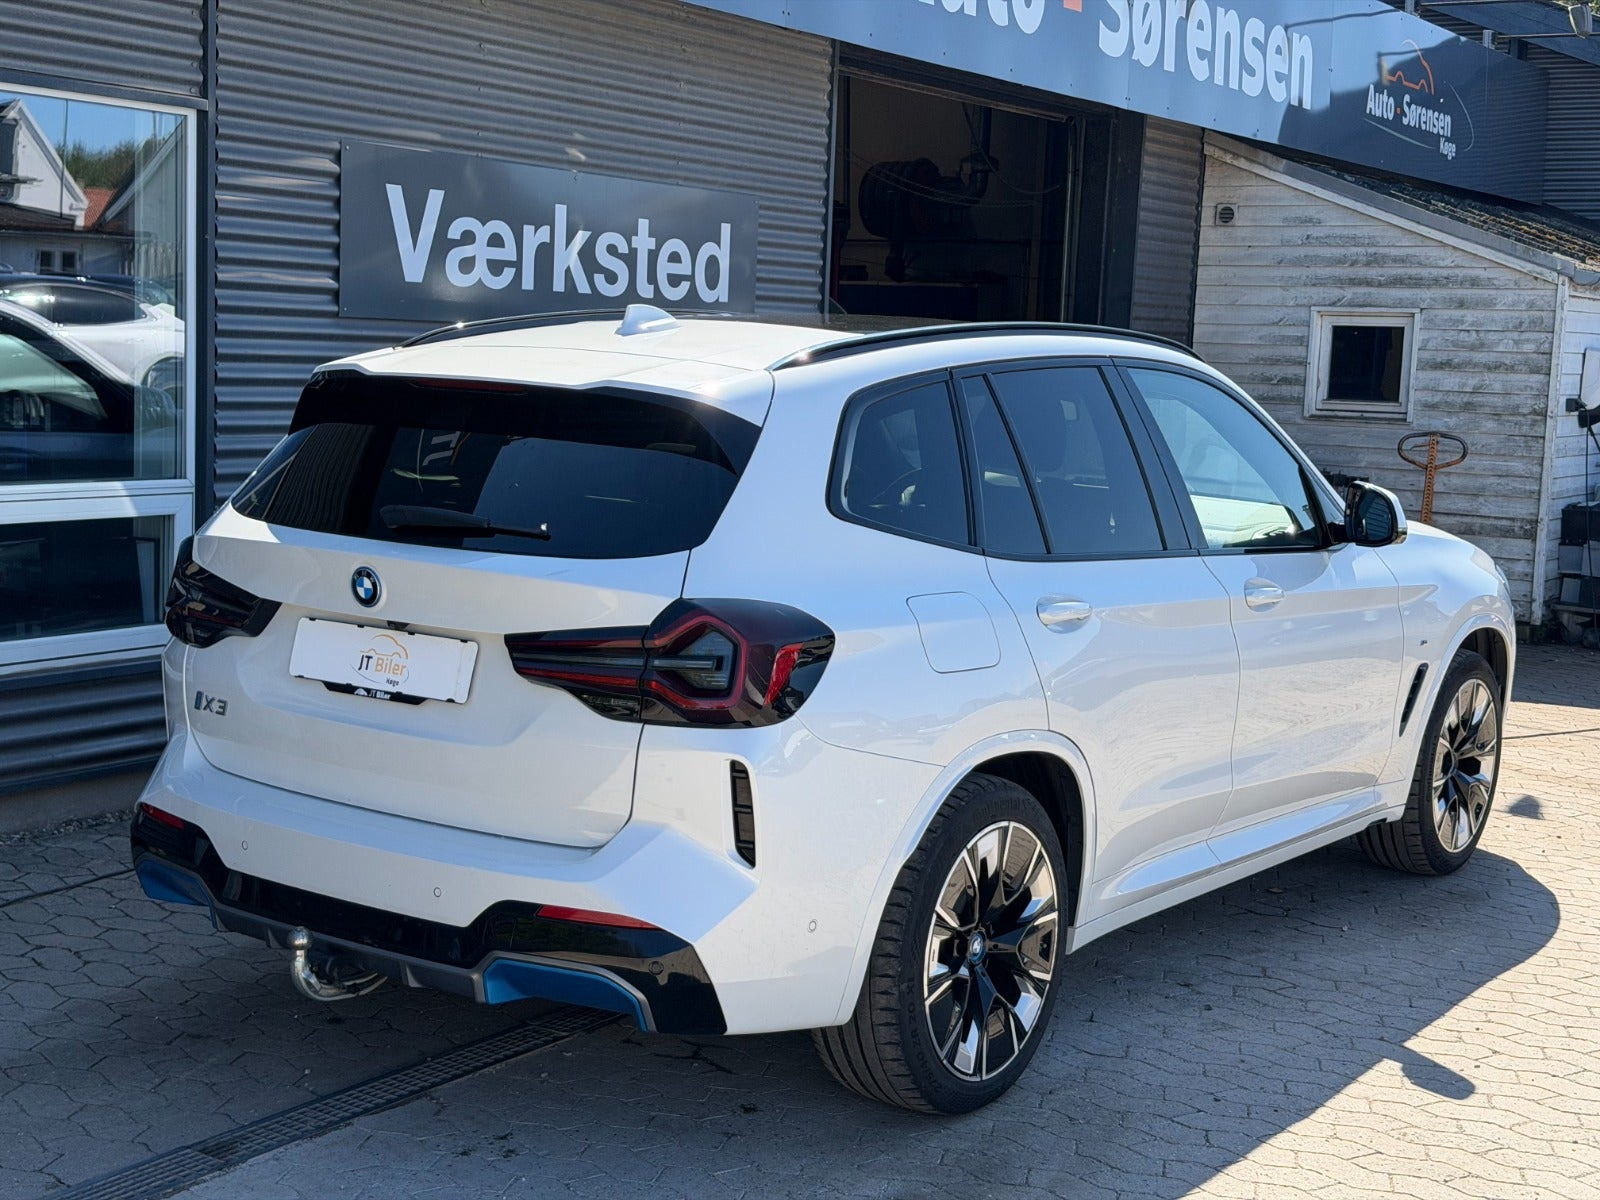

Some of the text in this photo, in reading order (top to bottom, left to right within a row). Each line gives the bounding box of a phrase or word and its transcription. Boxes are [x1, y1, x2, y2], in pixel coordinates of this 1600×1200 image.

[1099, 0, 1313, 110] Sørensen
[1366, 84, 1452, 137] Auto Sørensen
[1440, 137, 1457, 160] Køge
[385, 183, 732, 303] Værksted
[358, 655, 406, 676] JT Biler
